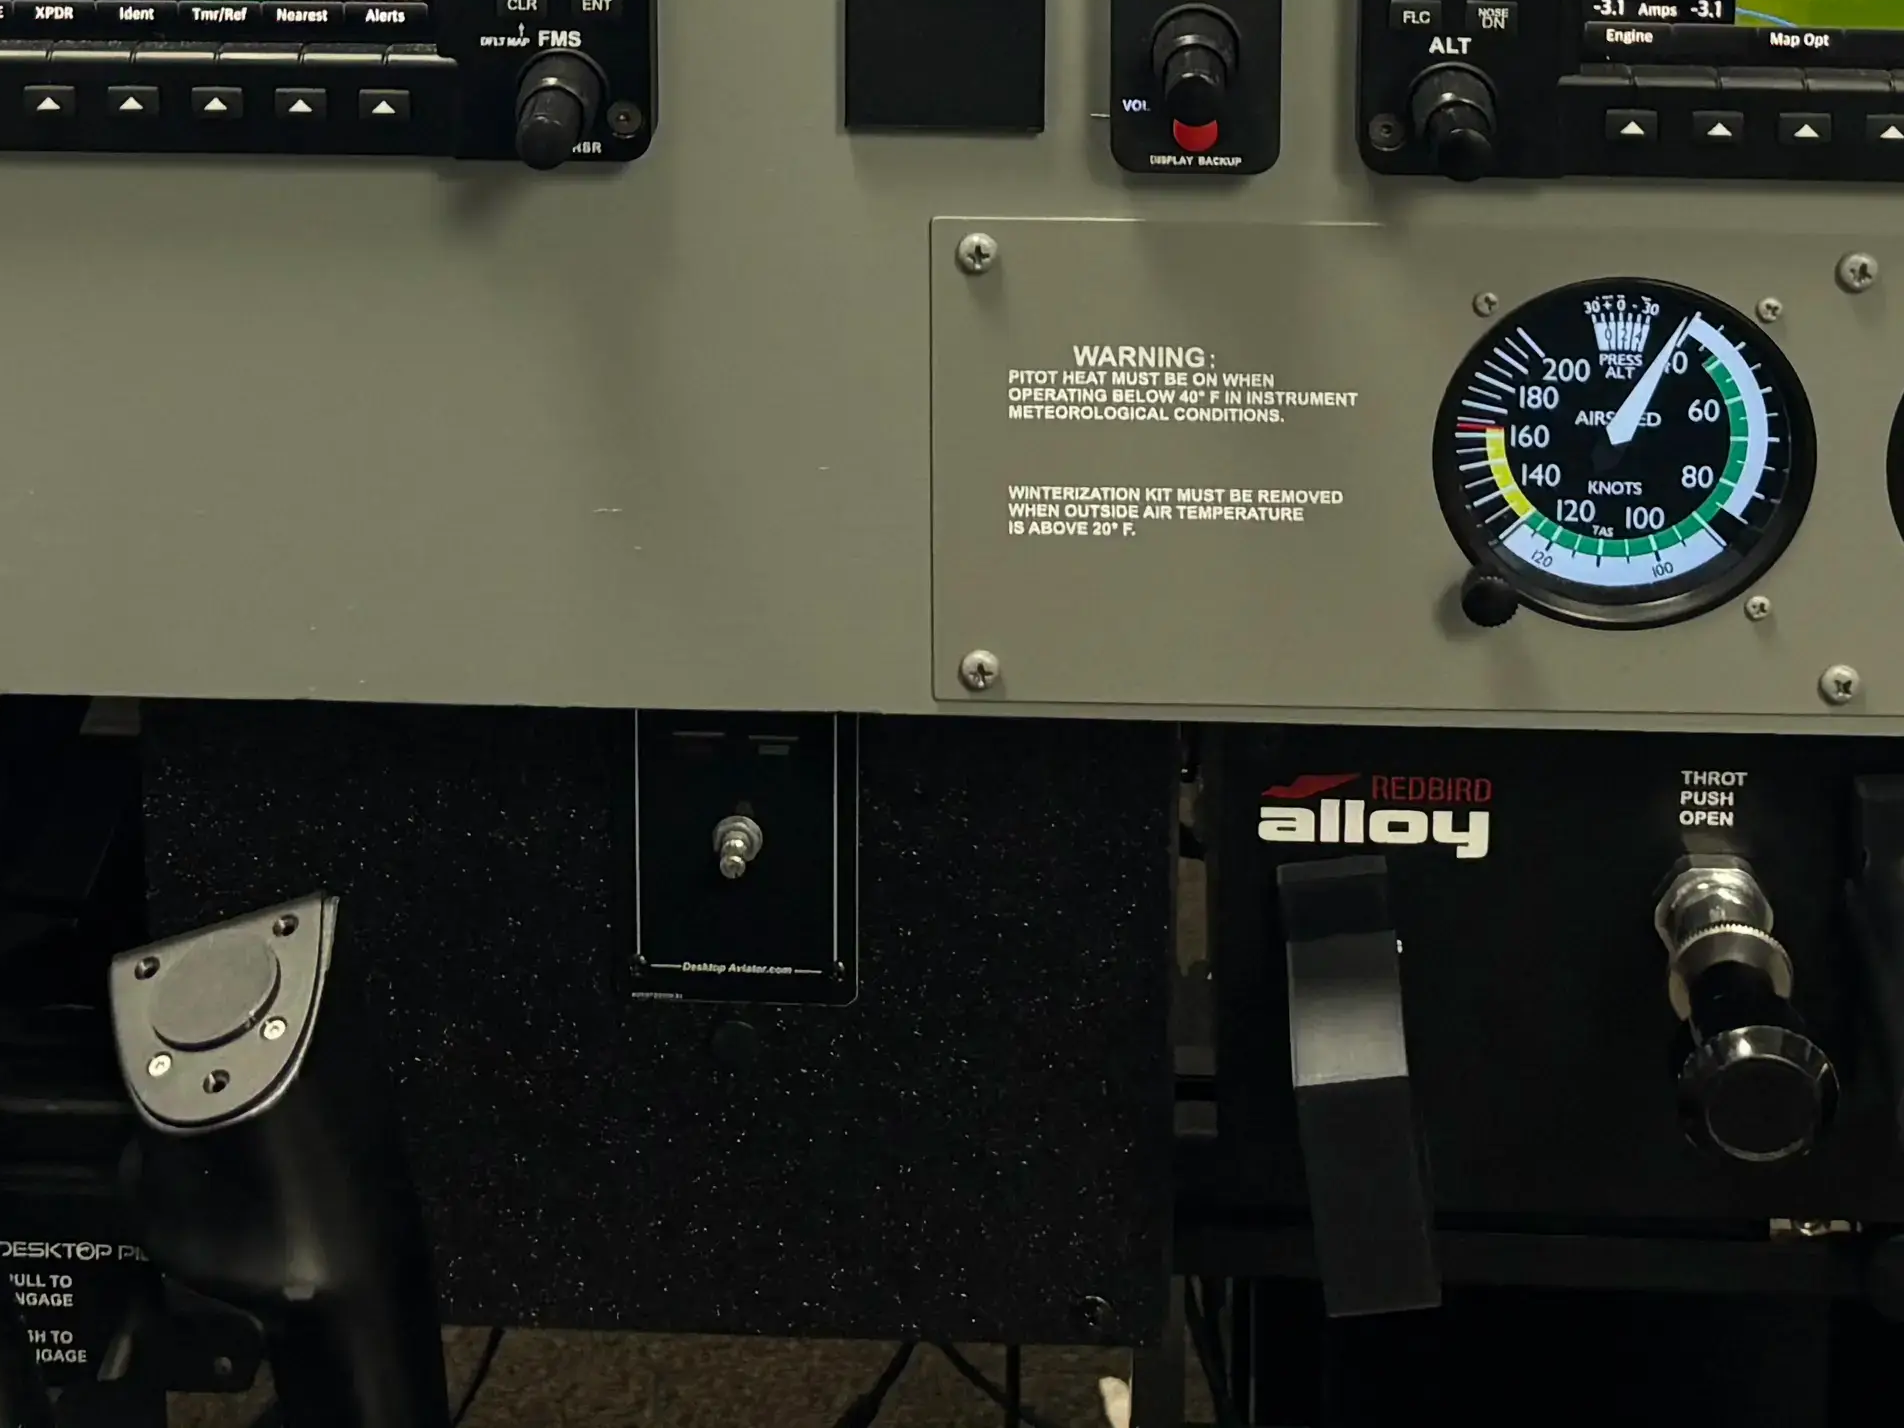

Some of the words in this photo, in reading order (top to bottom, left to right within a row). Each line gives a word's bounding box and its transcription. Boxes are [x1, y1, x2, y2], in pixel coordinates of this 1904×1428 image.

[277, 8, 327, 22] Nearest
[366, 9, 404, 23] Alerts
[539, 30, 581, 48] FMS
[1606, 28, 1652, 45] Engine
[1009, 371, 1058, 384] PITOT
[1063, 372, 1107, 385] HEAT
[1112, 372, 1159, 386] MUST
[1165, 373, 1187, 386] BE
[1193, 373, 1217, 386] ON
[1223, 374, 1274, 387] WHEN
[1542, 359, 1590, 382] 200
[1009, 389, 1107, 402] OPERATING
[1113, 390, 1174, 403] BELOW
[1225, 392, 1241, 405] IN
[1247, 392, 1358, 406] INSTRUMENT
[1519, 386, 1559, 409] 180
[1009, 406, 1168, 421] METEOROLOGICAL
[1174, 408, 1284, 423] CONDITIONS.
[1688, 400, 1720, 422] 60
[1510, 425, 1549, 448] 160
[1521, 464, 1560, 486] 140
[1682, 466, 1714, 488] 80
[1009, 486, 1140, 501] WINTERIZATION
[1146, 488, 1172, 502] KIT
[1177, 489, 1224, 502] MUST
[1230, 490, 1252, 503] BE
[1258, 490, 1343, 504] REMOVED
[1588, 481, 1642, 495] KNOTS
[1009, 504, 1060, 517] WHEN
[1065, 504, 1138, 518] OUTSIDE
[1144, 506, 1171, 519] AIR
[1177, 506, 1303, 521] TEMPERATURE
[1557, 500, 1595, 522] 120
[1625, 508, 1664, 530] 100
[1009, 522, 1024, 534] IS
[1029, 522, 1088, 535] ABOVE
[1682, 770, 1748, 787] THROT
[1373, 776, 1490, 803] REDBIRD
[1681, 790, 1734, 806] PUSH
[1680, 810, 1734, 826] OPEN
[1258, 800, 1489, 858] alloy
